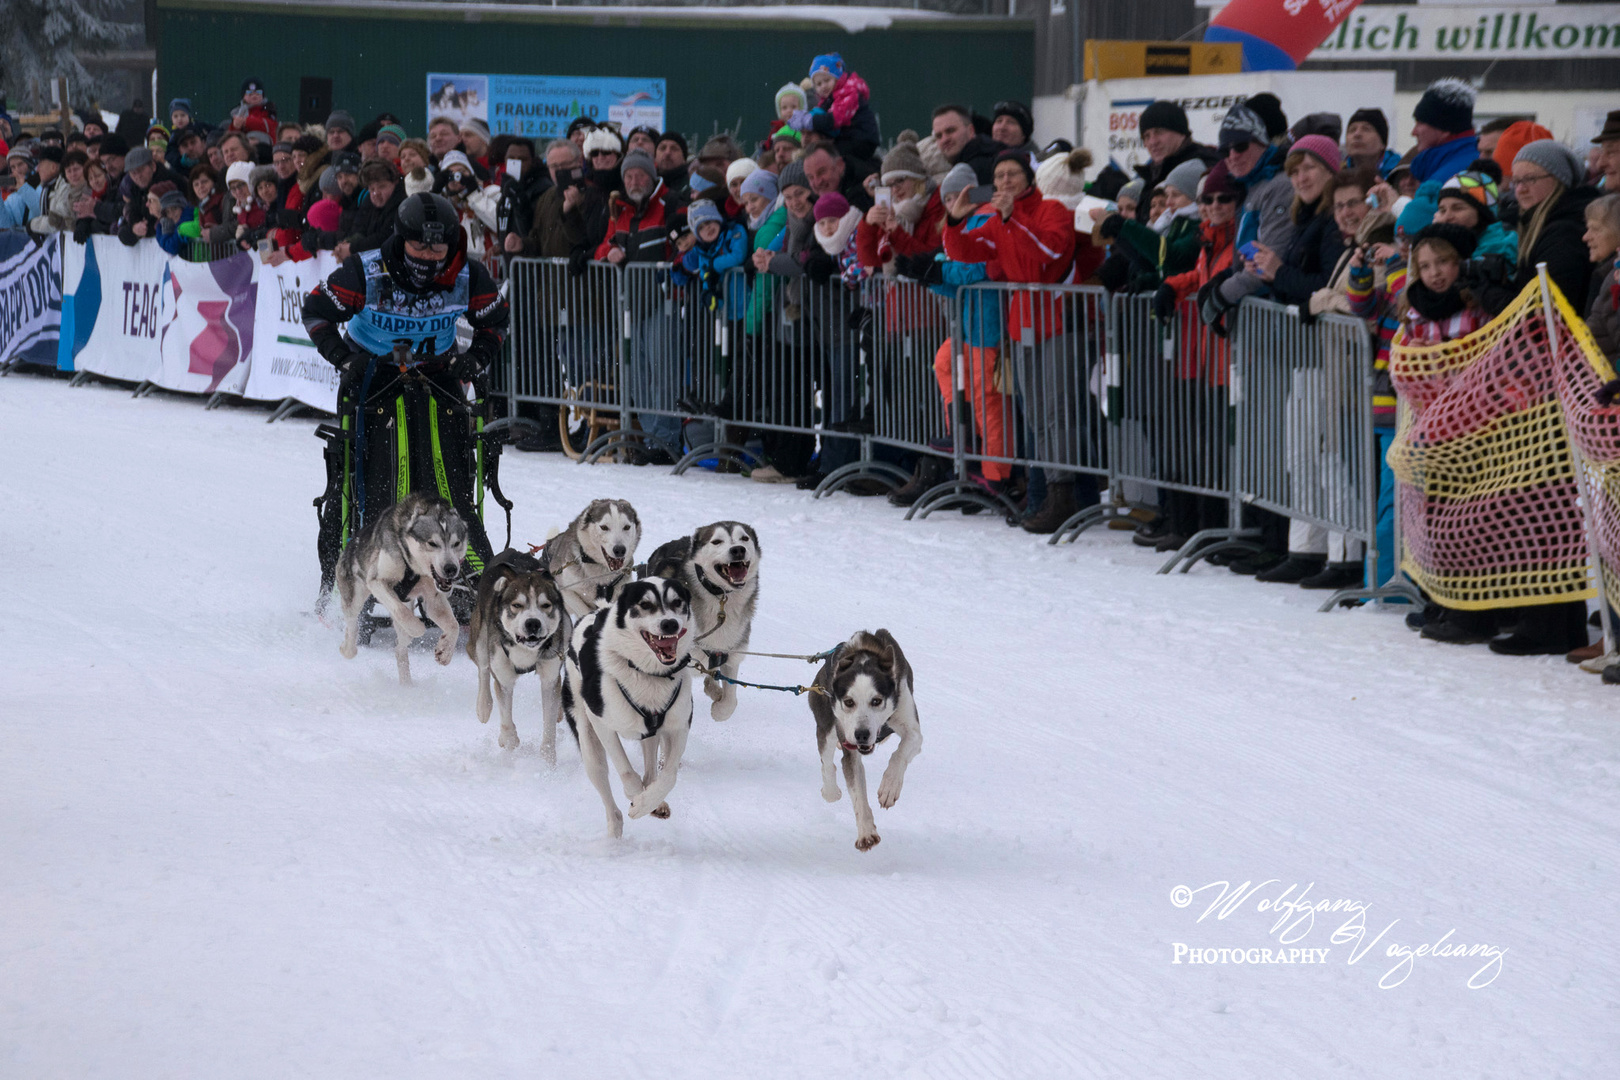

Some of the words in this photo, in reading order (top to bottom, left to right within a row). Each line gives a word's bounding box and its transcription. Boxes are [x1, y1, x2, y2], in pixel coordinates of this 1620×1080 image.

[1435, 13, 1620, 51] willkom
[496, 98, 599, 117] FRAUENWALD
[1109, 112, 1141, 130] BOS
[122, 281, 159, 339] TEAG
[371, 311, 427, 333] HAPPY
